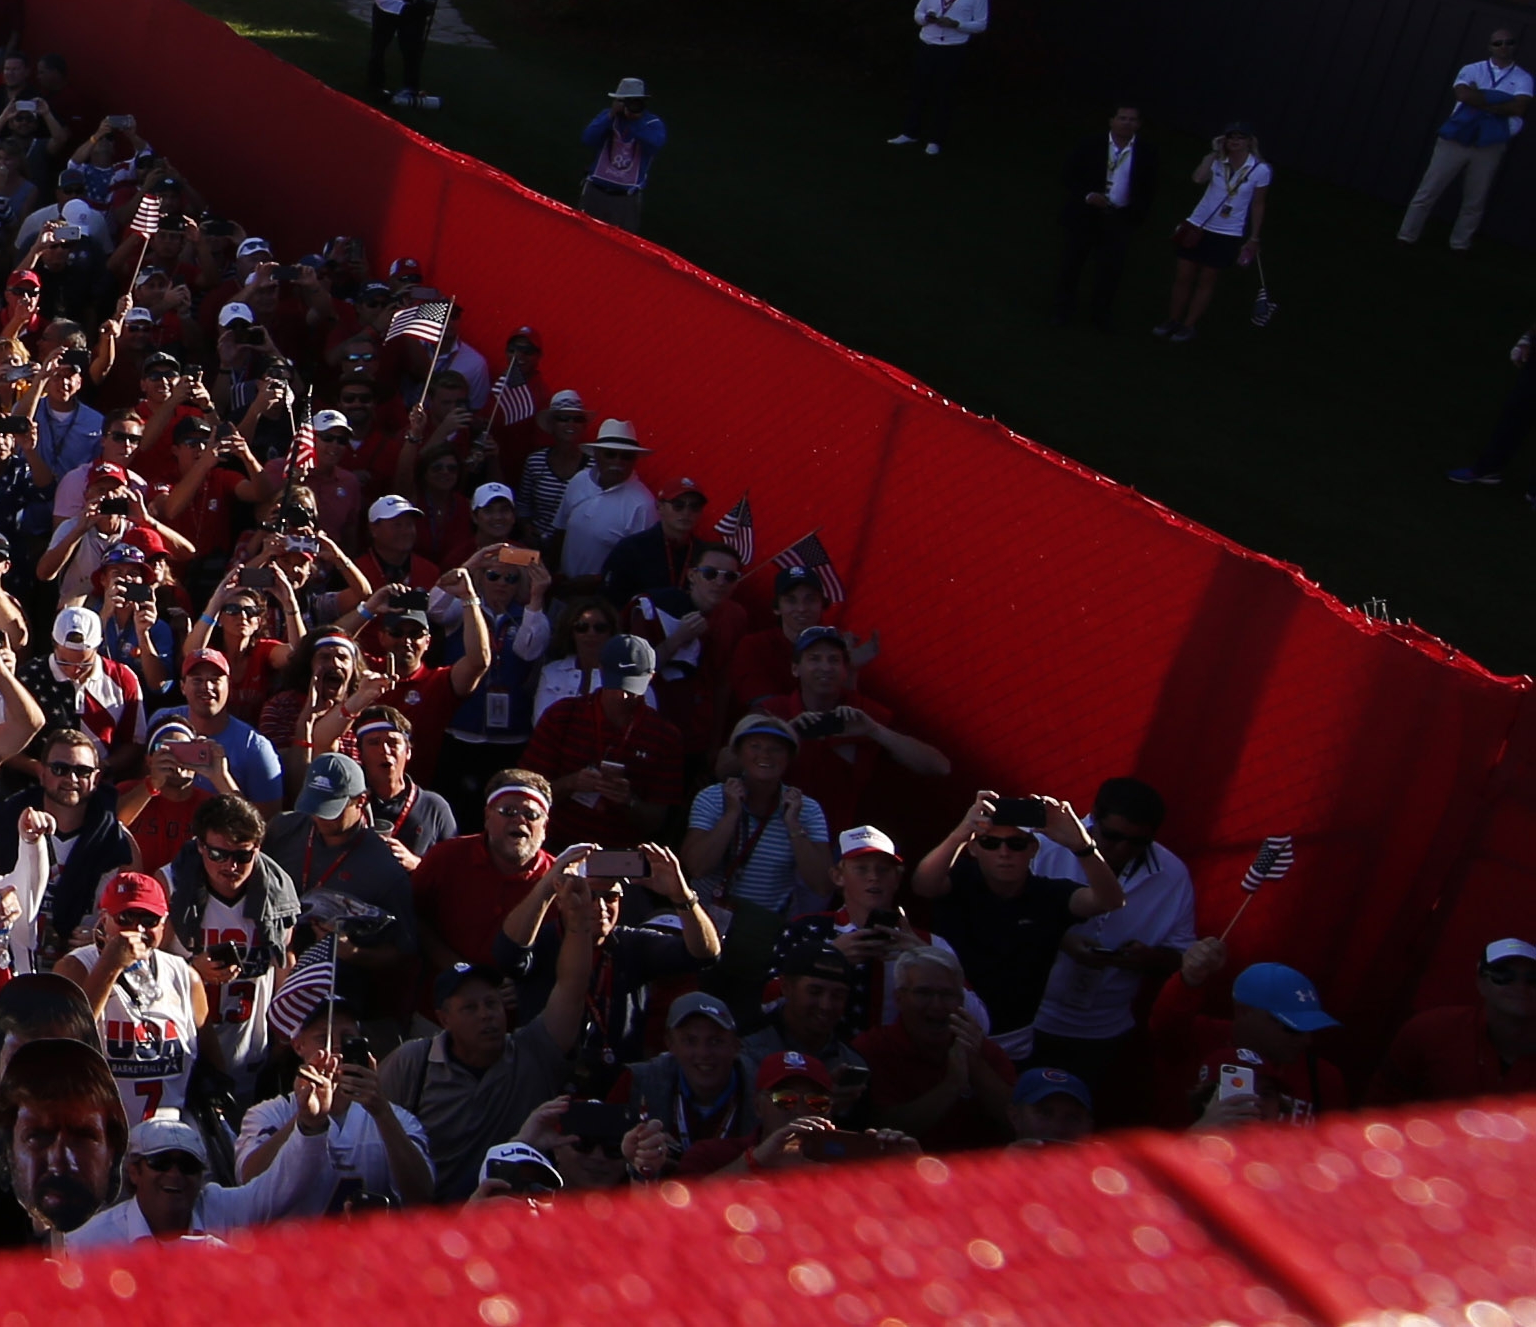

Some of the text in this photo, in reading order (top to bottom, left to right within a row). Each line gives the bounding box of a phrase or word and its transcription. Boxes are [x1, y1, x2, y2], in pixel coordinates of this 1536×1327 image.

[111, 1061, 161, 1074] BASKETBALL
[134, 1079, 164, 1122] 7
[500, 1148, 543, 1162] USA
